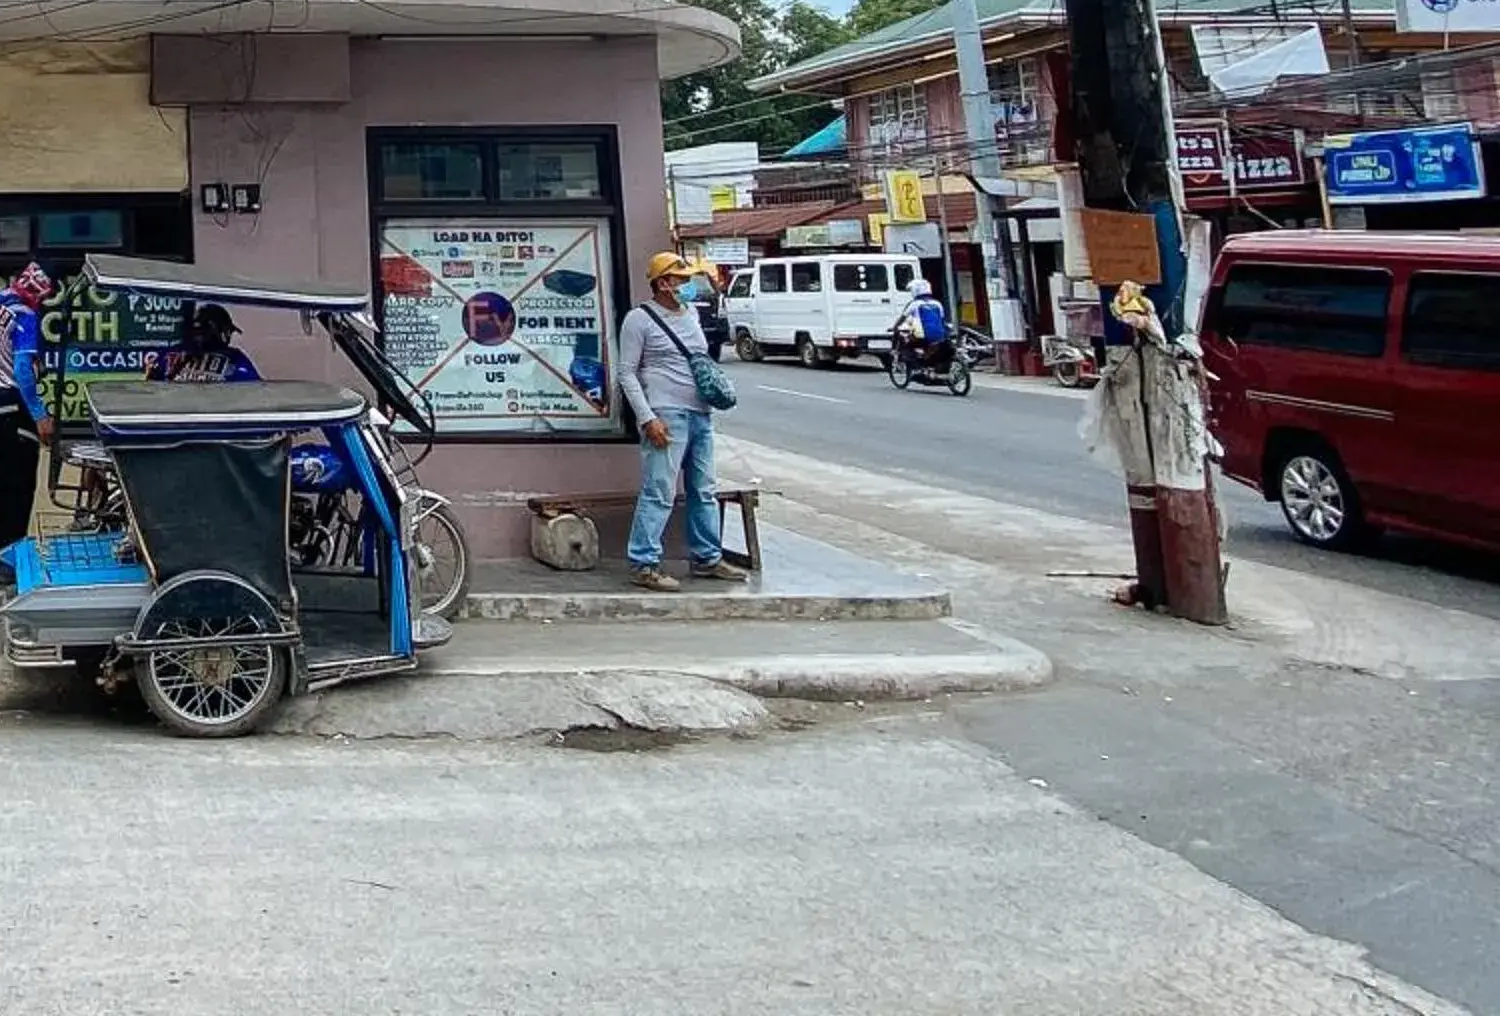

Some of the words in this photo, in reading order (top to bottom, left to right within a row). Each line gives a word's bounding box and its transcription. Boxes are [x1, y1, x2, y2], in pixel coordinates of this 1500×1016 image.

[1227, 154, 1292, 180] izza
[433, 231, 468, 243] LOAD
[496, 231, 534, 243] DITO!
[518, 316, 550, 329] FOR
[554, 316, 597, 329] RENT
[464, 354, 522, 366] FOLLOW
[485, 371, 506, 383] US
